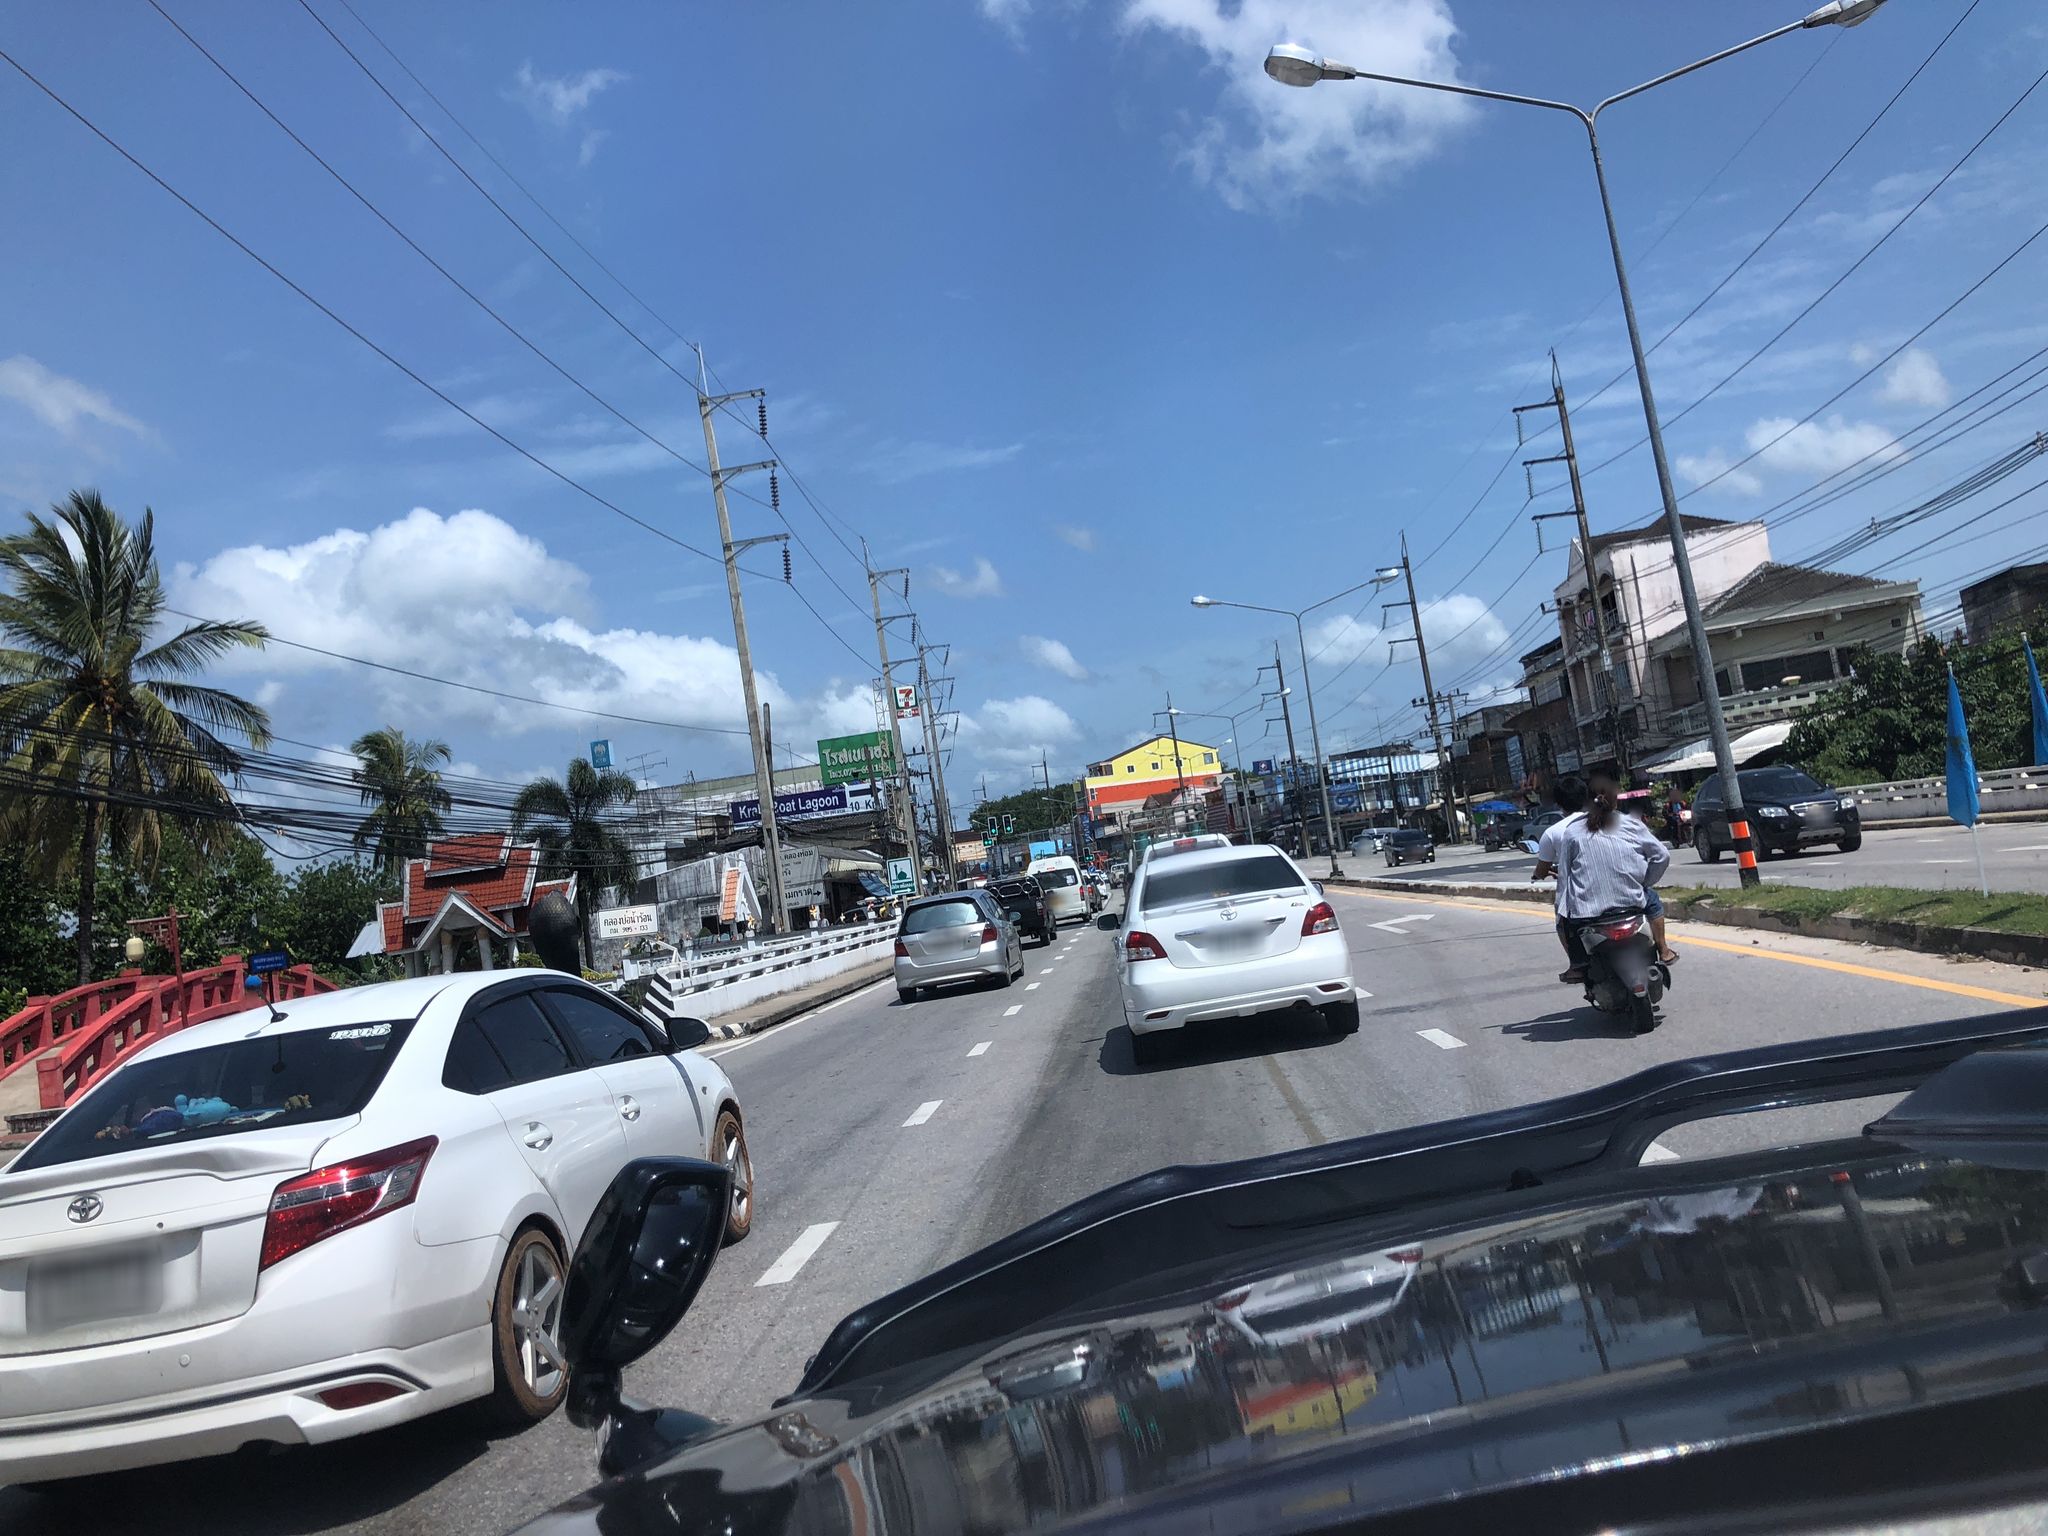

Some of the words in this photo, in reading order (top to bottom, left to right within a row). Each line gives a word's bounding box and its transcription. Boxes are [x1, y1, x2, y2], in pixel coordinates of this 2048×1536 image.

[898, 688, 913, 708] 7
[798, 795, 839, 811] Lagoon
[849, 801, 860, 811] 10
[603, 910, 652, 927] คลองบ่อน้ำร้อน
